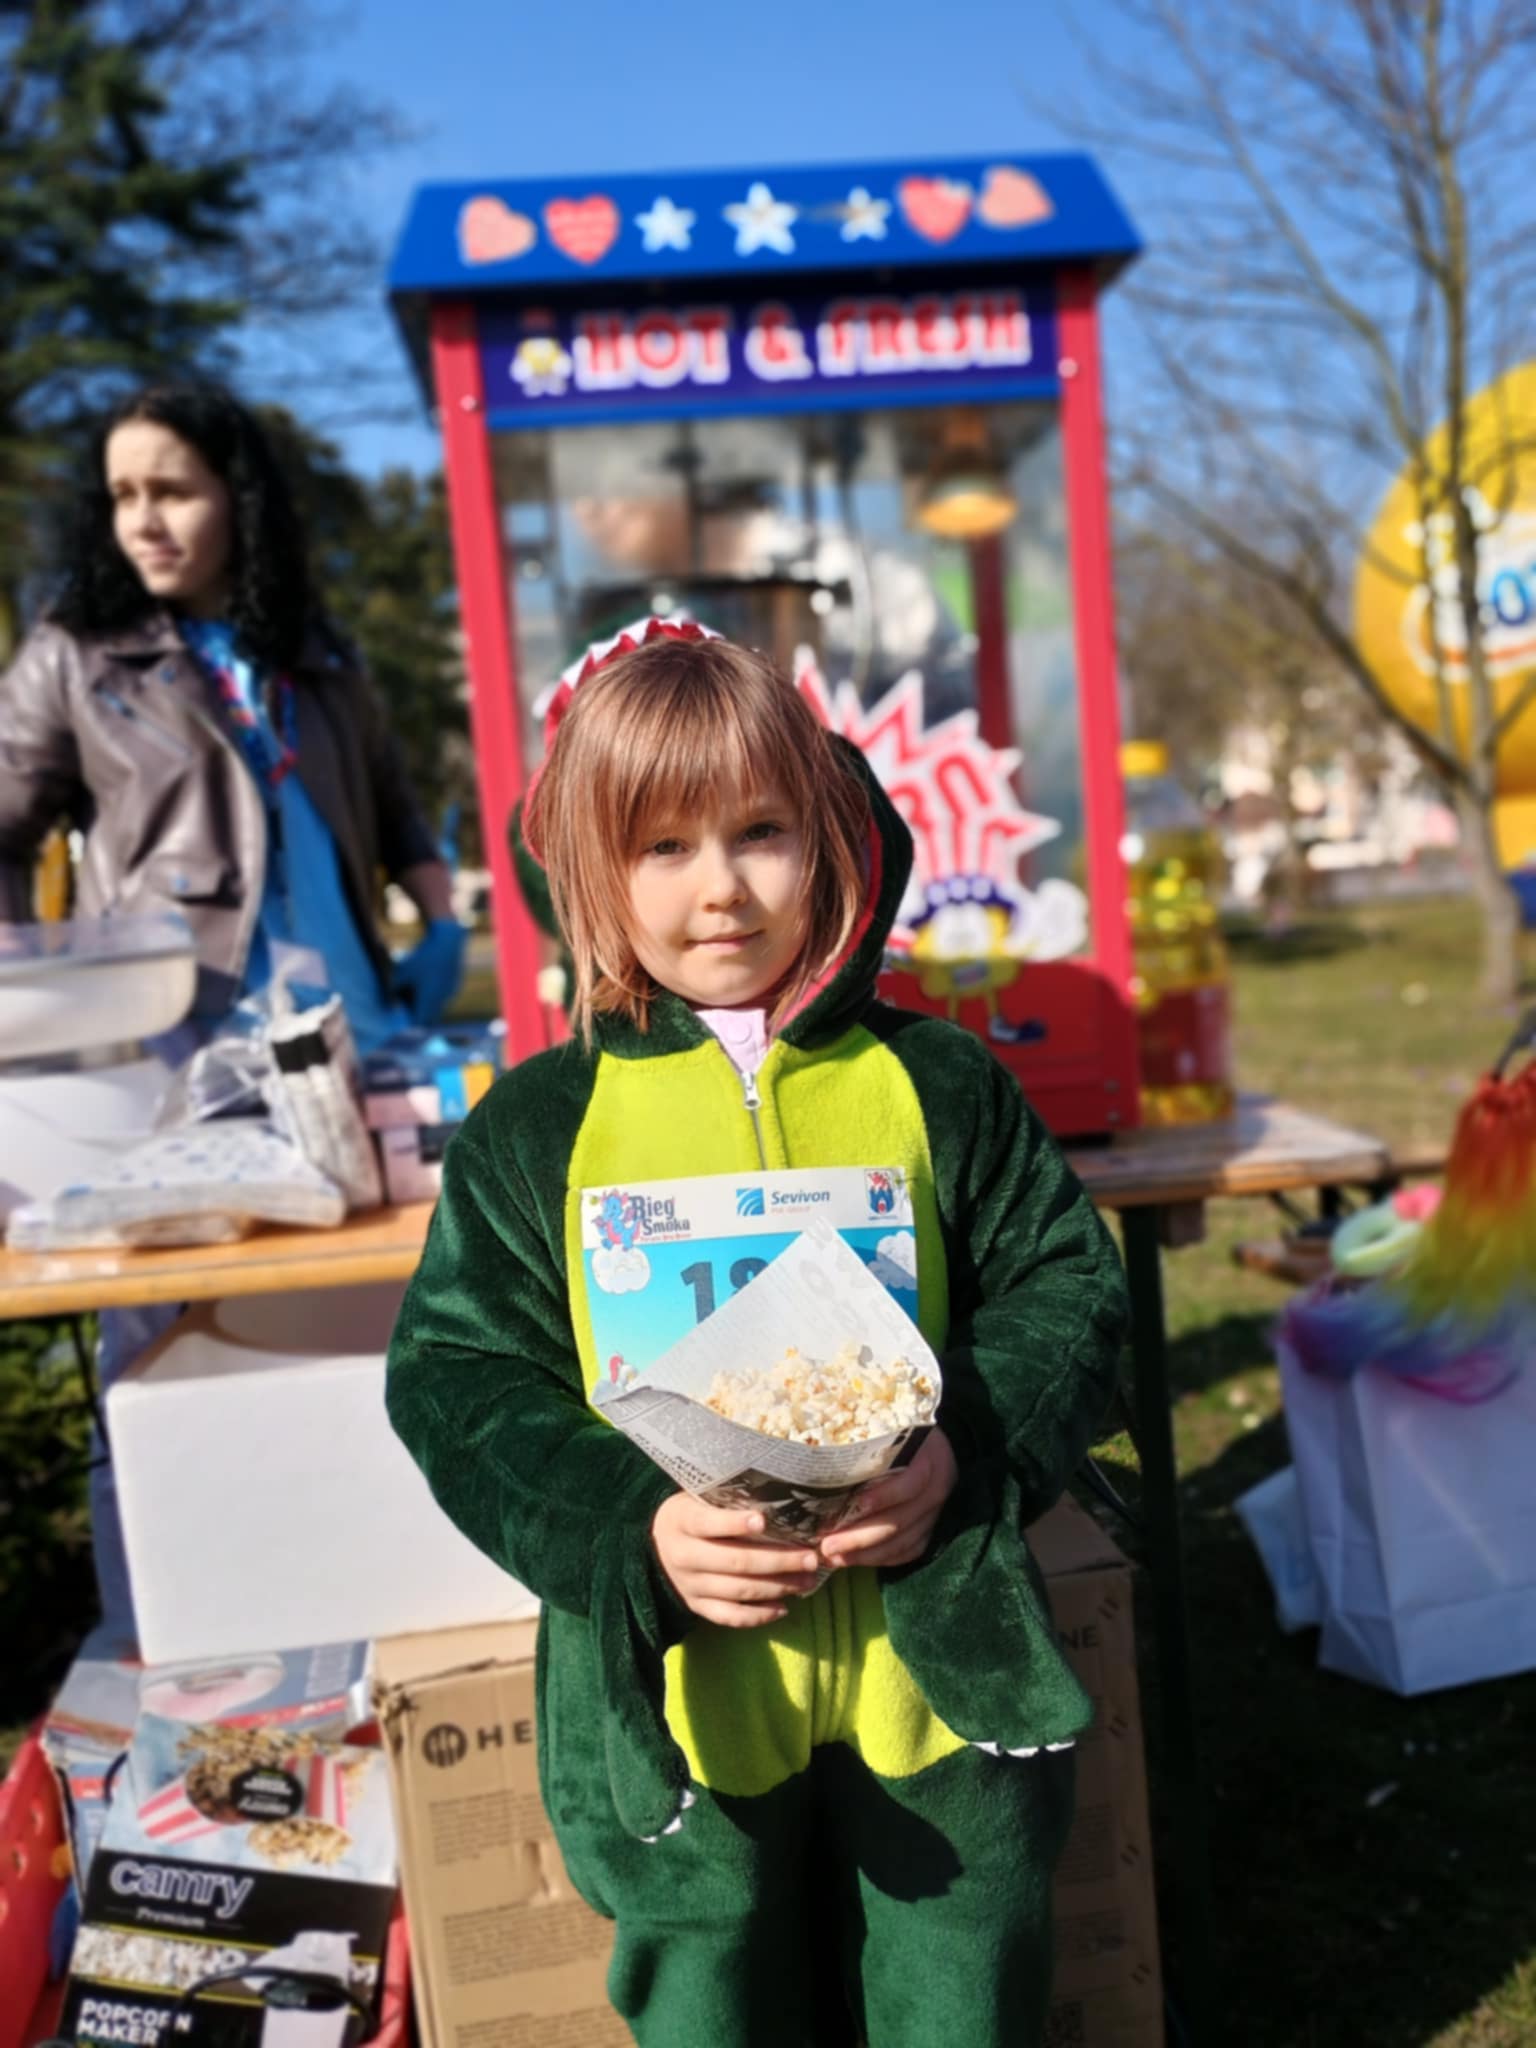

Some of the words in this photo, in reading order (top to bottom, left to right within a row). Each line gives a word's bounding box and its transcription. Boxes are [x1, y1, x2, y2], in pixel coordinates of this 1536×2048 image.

[572, 311, 731, 391] HOT
[745, 304, 813, 381] &
[816, 292, 1031, 377] FRESH
[630, 1195, 675, 1220] Bieg
[771, 1189, 830, 1205] Sevivon
[642, 1217, 690, 1236] Smoka
[76, 2018, 160, 2047] MAKER
